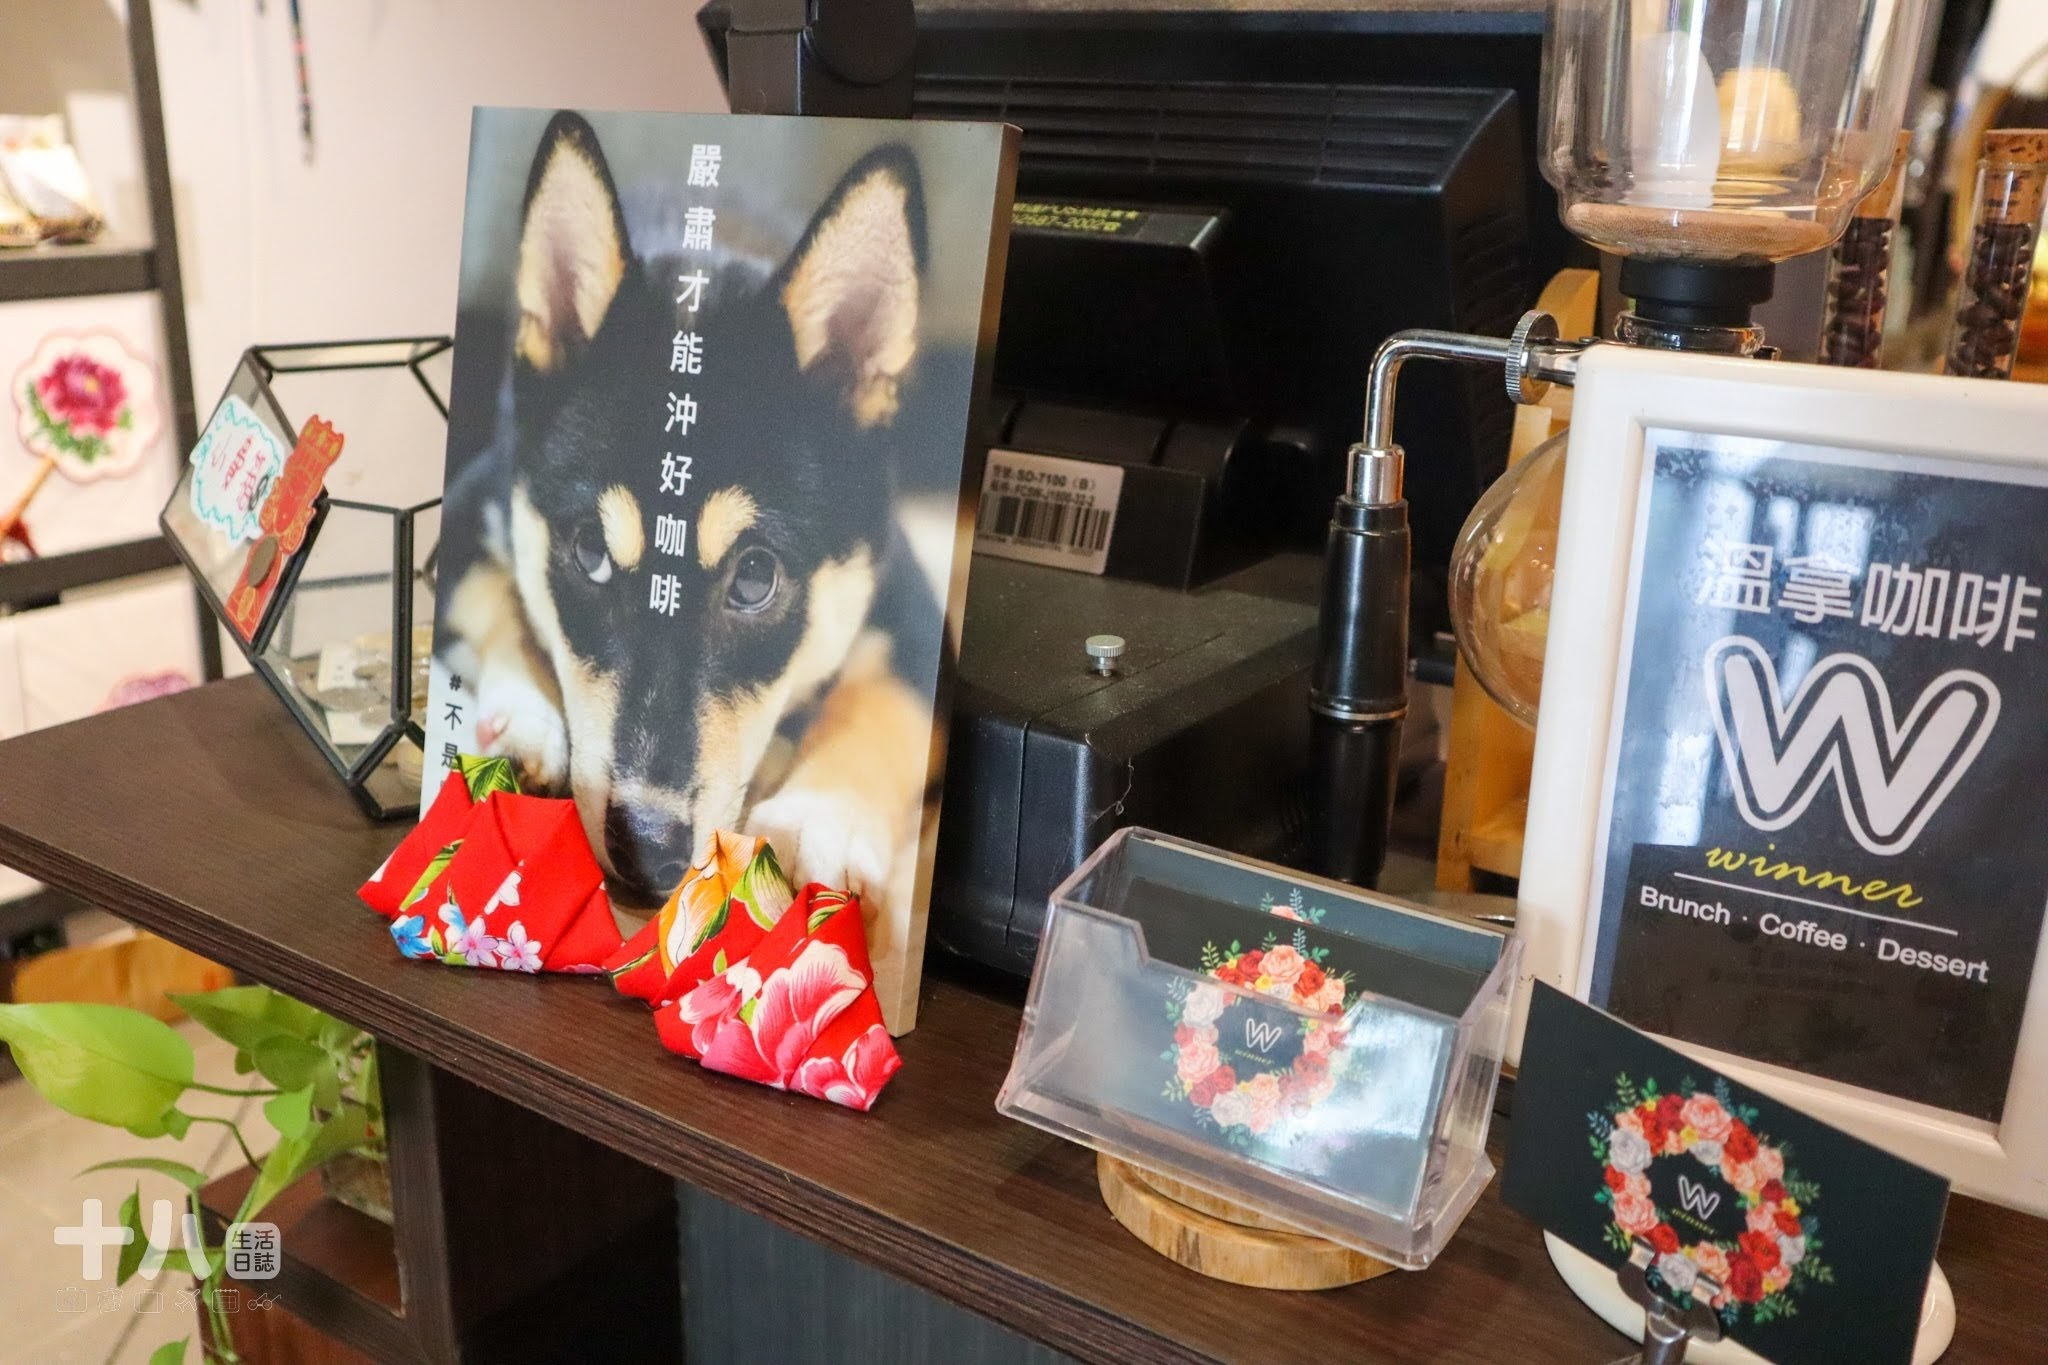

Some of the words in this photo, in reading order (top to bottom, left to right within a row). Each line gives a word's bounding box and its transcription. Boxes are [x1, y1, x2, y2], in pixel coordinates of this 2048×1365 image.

[649, 143, 722, 617] 嚴肅才能沖好咖啡
[1696, 538, 2043, 652] 溫拿咖啡
[441, 673, 463, 788] #不是
[1703, 634, 2001, 856] W
[1705, 842, 1923, 908] winner
[1640, 885, 1731, 926] Brunch
[1759, 912, 1848, 951] Coffee
[1877, 938, 1990, 983] Dessert
